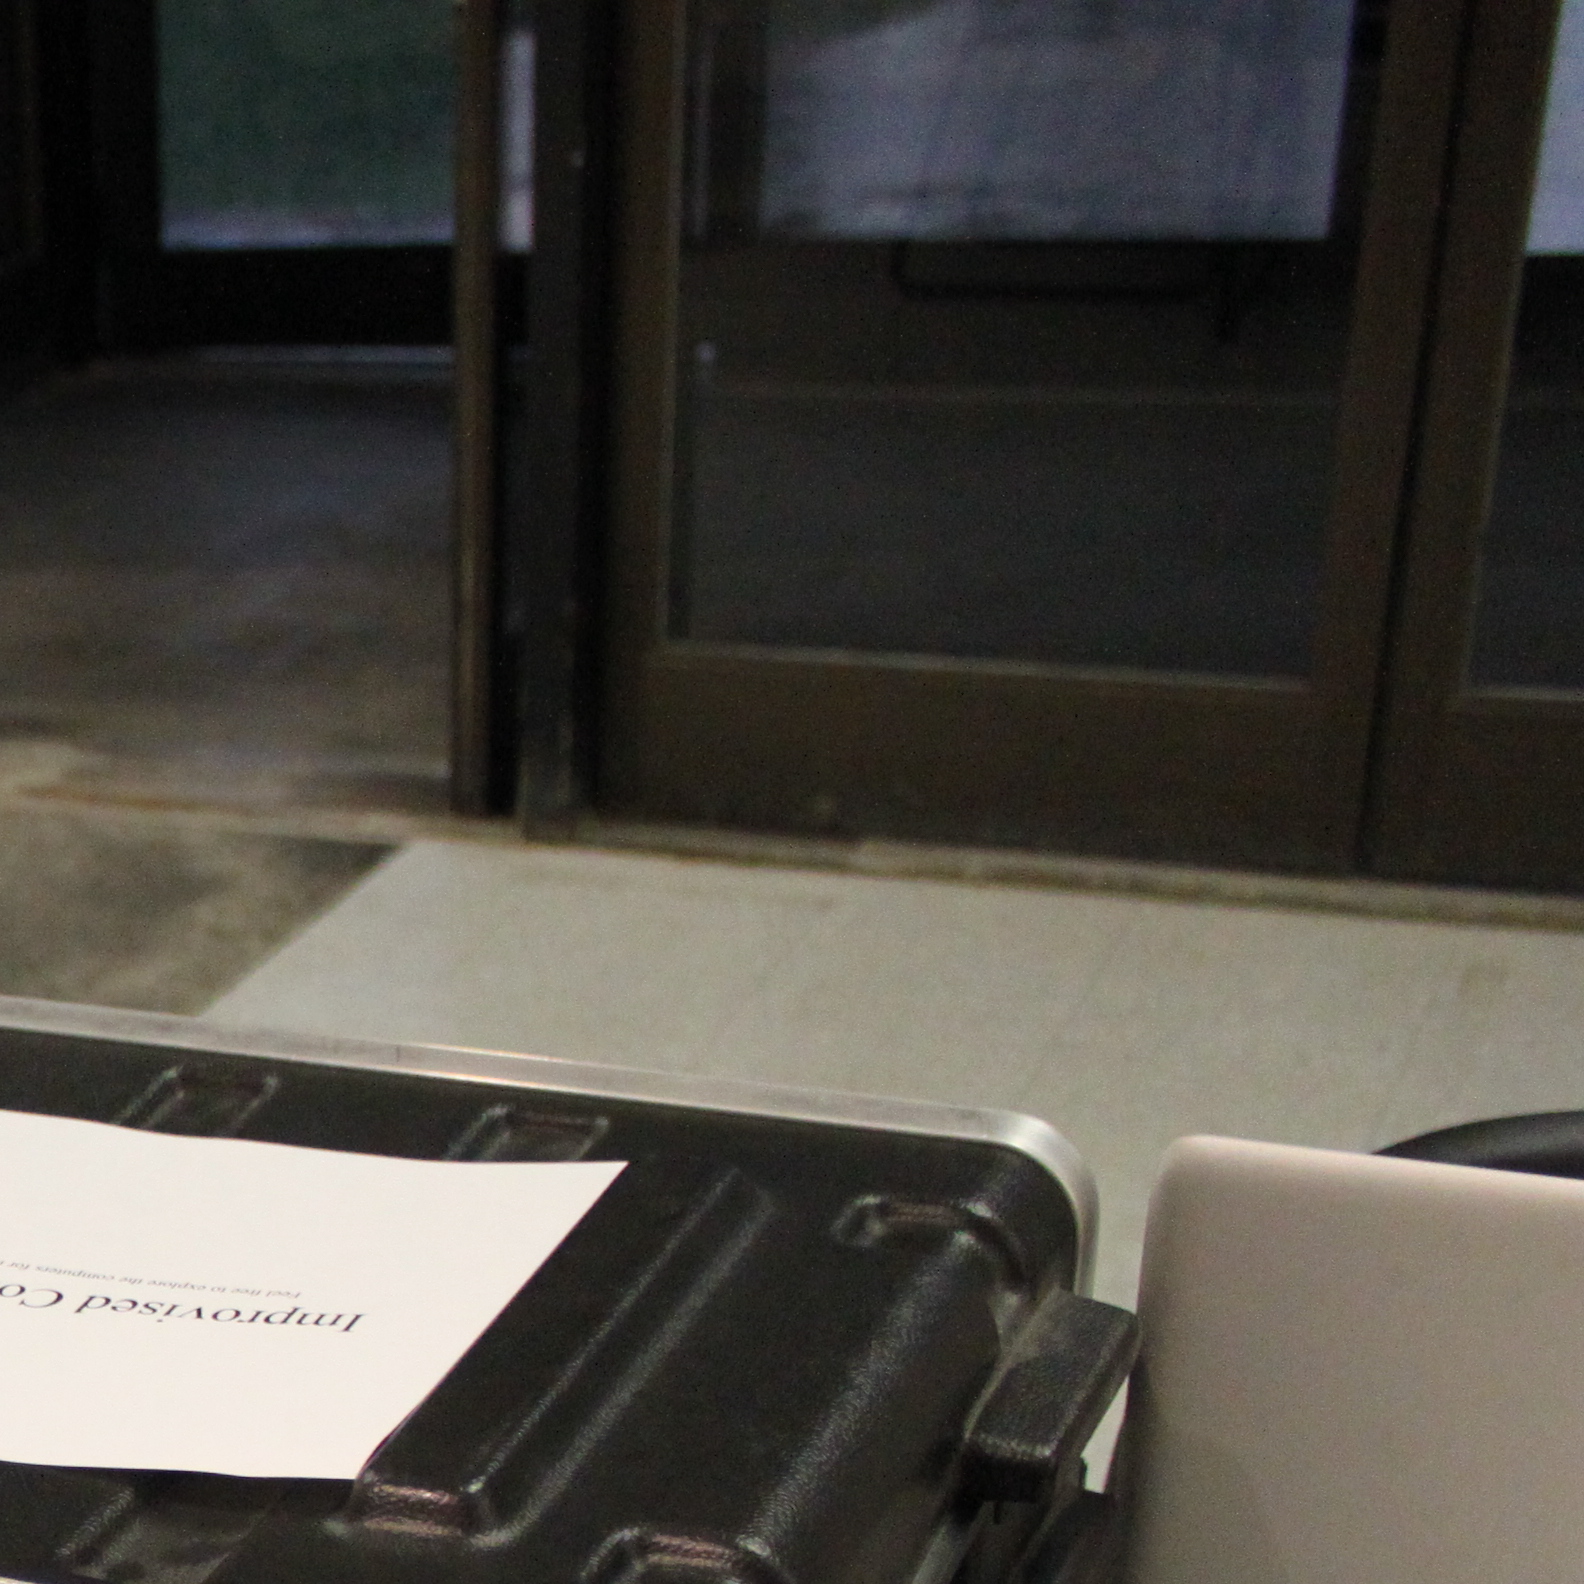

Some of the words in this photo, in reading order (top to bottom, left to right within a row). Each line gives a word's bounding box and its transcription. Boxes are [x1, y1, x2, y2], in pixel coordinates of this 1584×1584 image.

[10, 1260, 30, 1271] for
[35, 1264, 115, 1283] computers
[118, 1274, 144, 1285] the
[148, 1278, 207, 1291] explore
[211, 1285, 228, 1294] to
[231, 1287, 263, 1298] free
[265, 1289, 302, 1300] Feel
[74, 1293, 370, 1333] Improvised
